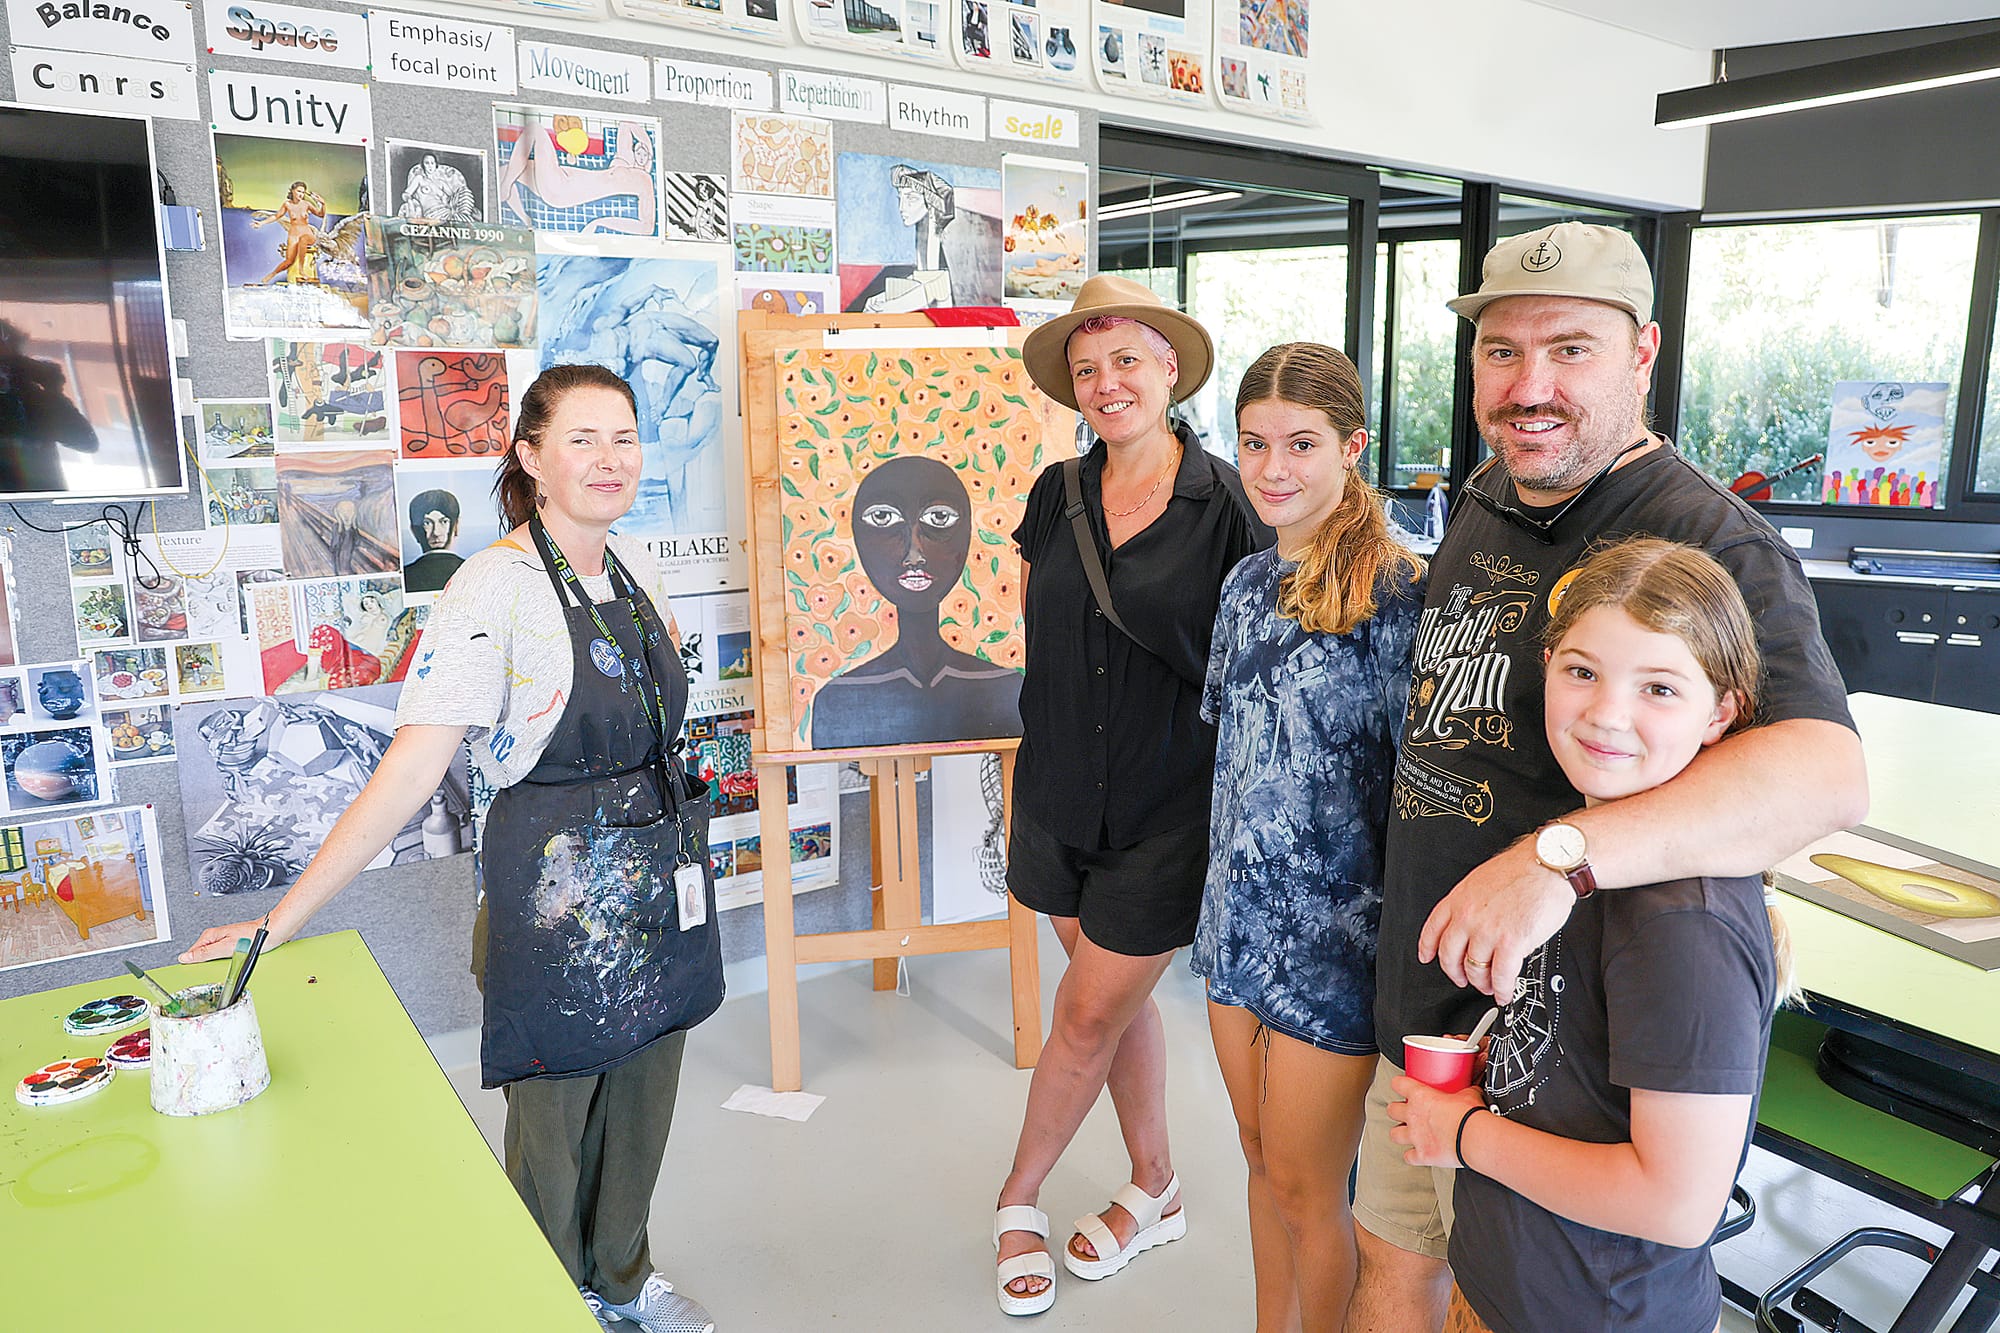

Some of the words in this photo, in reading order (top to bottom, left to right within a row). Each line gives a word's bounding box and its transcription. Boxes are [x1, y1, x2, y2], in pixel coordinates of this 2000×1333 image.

[36, 0, 171, 41] Balance
[226, 6, 338, 52] Space
[389, 20, 493, 52] Emphasis/
[391, 52, 439, 75] focal
[447, 63, 497, 82] point
[529, 47, 630, 95] Movement
[666, 65, 753, 101] Proportion
[786, 75, 873, 112] Repetition
[227, 84, 348, 134] Unity
[899, 102, 970, 129] Rhythm
[1004, 115, 1063, 139] scale
[400, 223, 472, 240] CEZANNE
[474, 229, 504, 242] 1990
[159, 535, 202, 546] Texture
[659, 537, 729, 558] BLAKE
[687, 695, 745, 714] AUVISM
